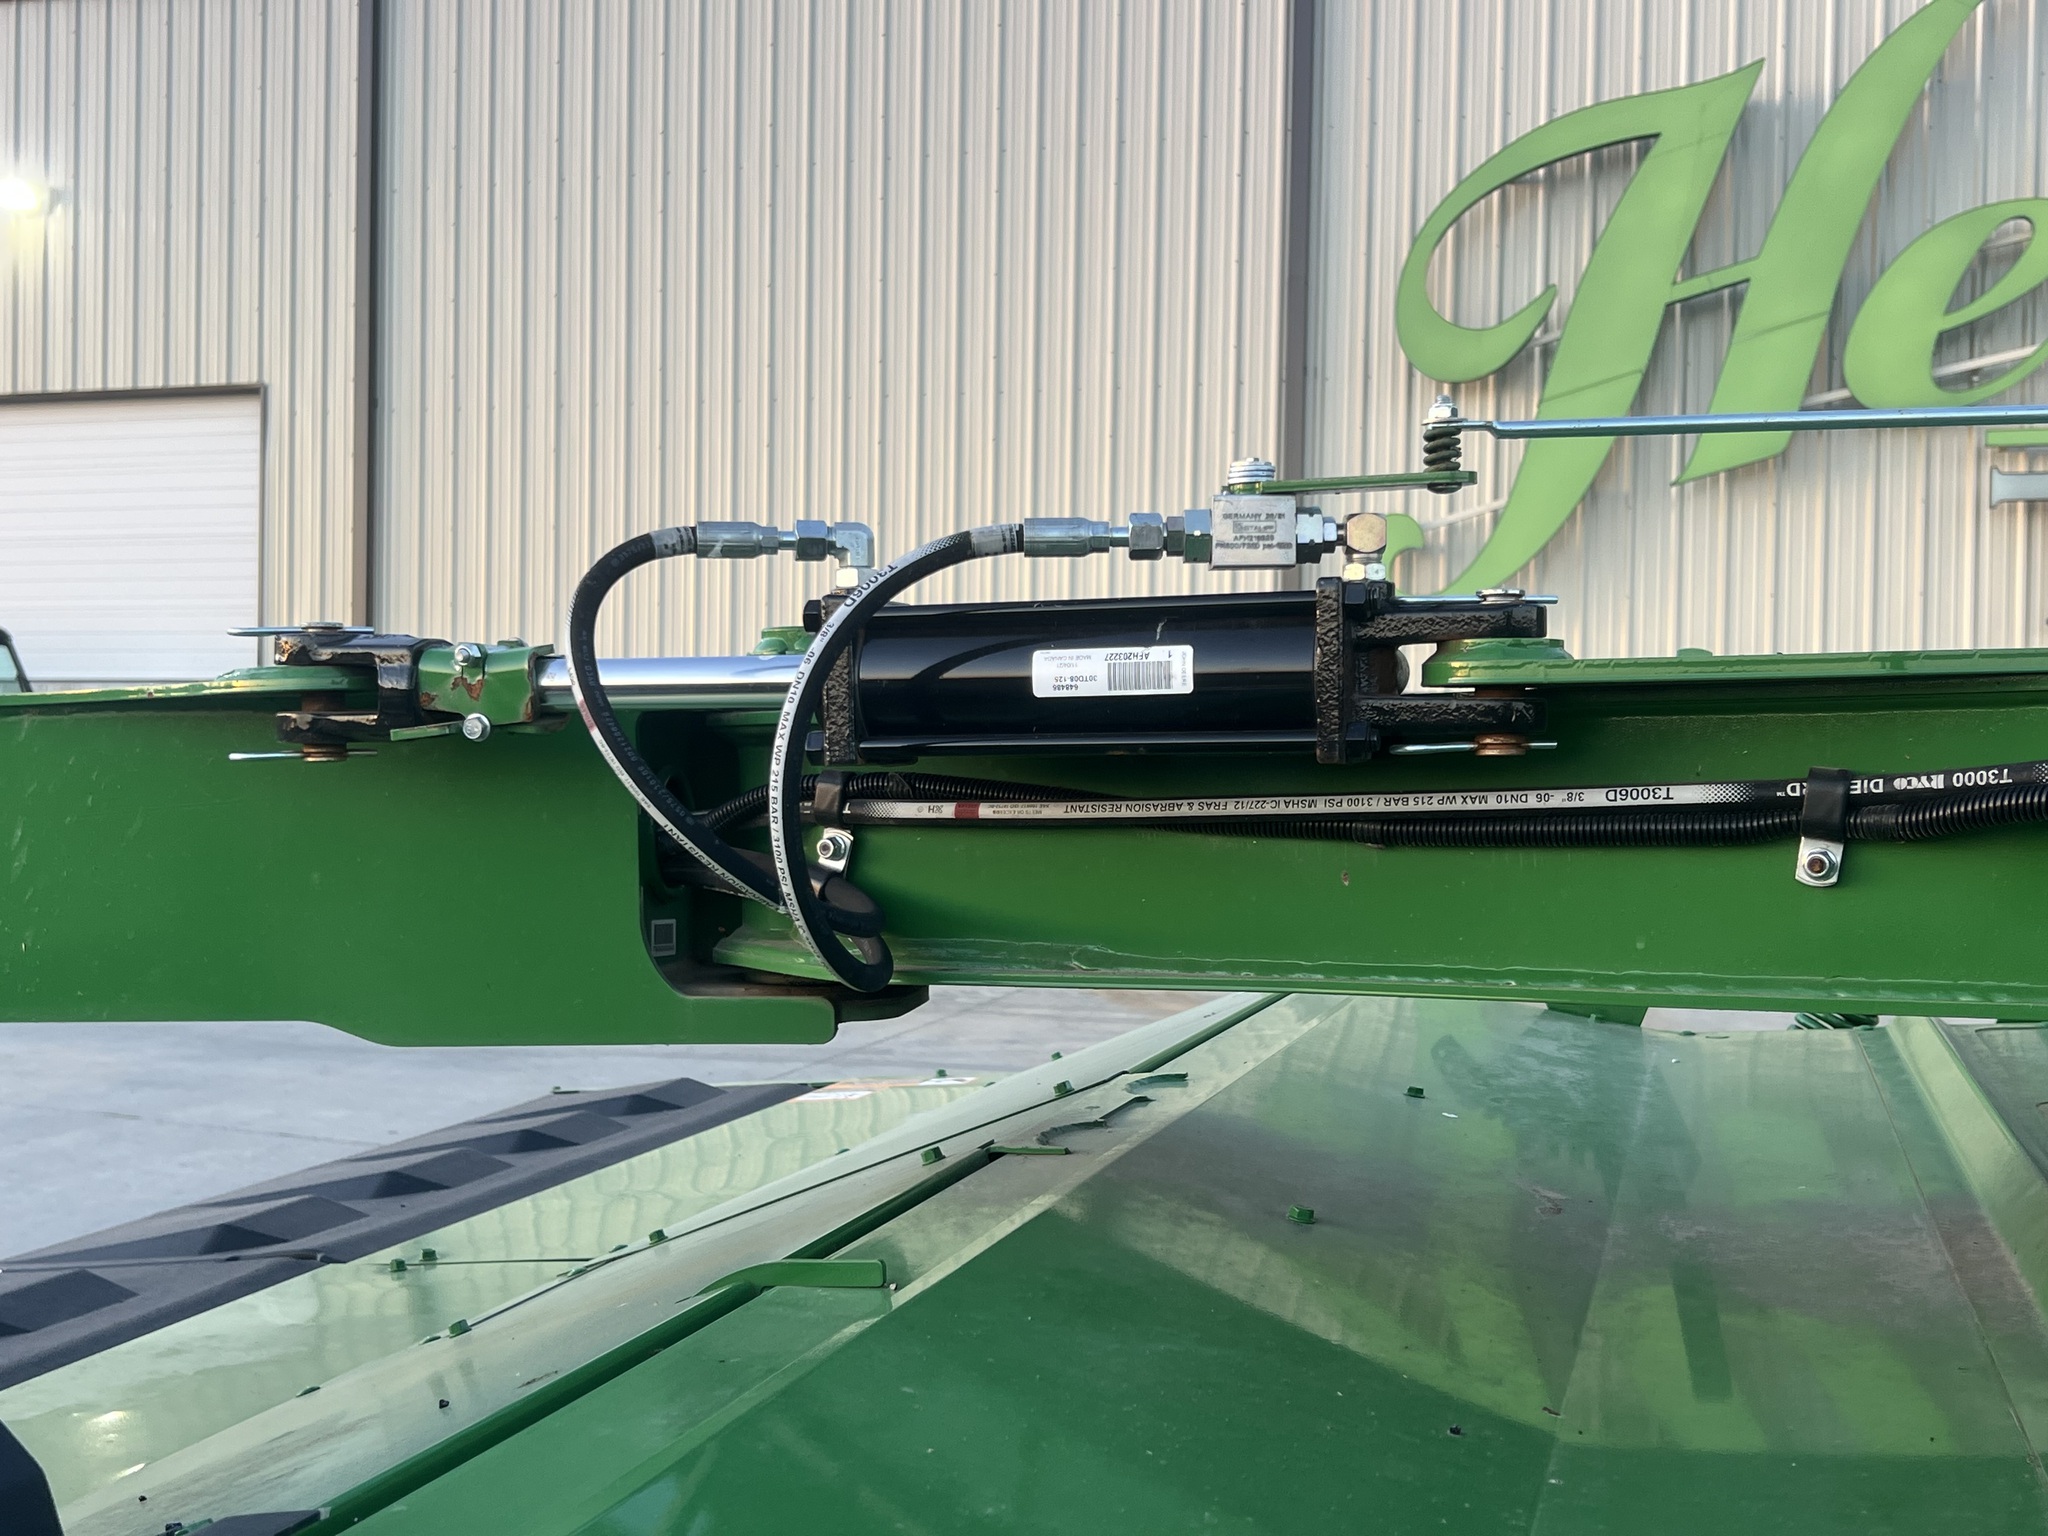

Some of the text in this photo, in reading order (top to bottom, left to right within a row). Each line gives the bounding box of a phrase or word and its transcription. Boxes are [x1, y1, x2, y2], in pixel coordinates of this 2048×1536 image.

[1222, 512, 1262, 520] GERMANY
[843, 563, 899, 608] T3006D
[1104, 651, 1151, 661] AFH203227
[787, 671, 805, 704] DN10
[777, 711, 791, 741] MAX
[774, 744, 783, 766] WP
[771, 770, 780, 792] 215
[1952, 768, 2013, 788] T3000
[1461, 794, 1489, 805] MAX
[1495, 793, 1528, 804] DN10
[1535, 792, 1555, 803] -06
[1561, 791, 1585, 803] 3/8"
[1605, 786, 1674, 802] T3006D
[1186, 801, 1194, 811] &
[1197, 800, 1228, 811] FRAS
[1233, 799, 1281, 810] IC-227/12
[1284, 798, 1318, 809] MSHA
[1324, 798, 1343, 808] PSI
[1346, 797, 1373, 808] 3100
[1384, 796, 1409, 807] BAR
[1412, 795, 1434, 806] 215
[1437, 795, 1457, 806] WP
[770, 796, 779, 825] BAR
[1063, 803, 1122, 814] RESISTANT
[1125, 801, 1184, 813] ABRASION
[772, 836, 783, 864] 3100
[778, 867, 789, 887] PSI
